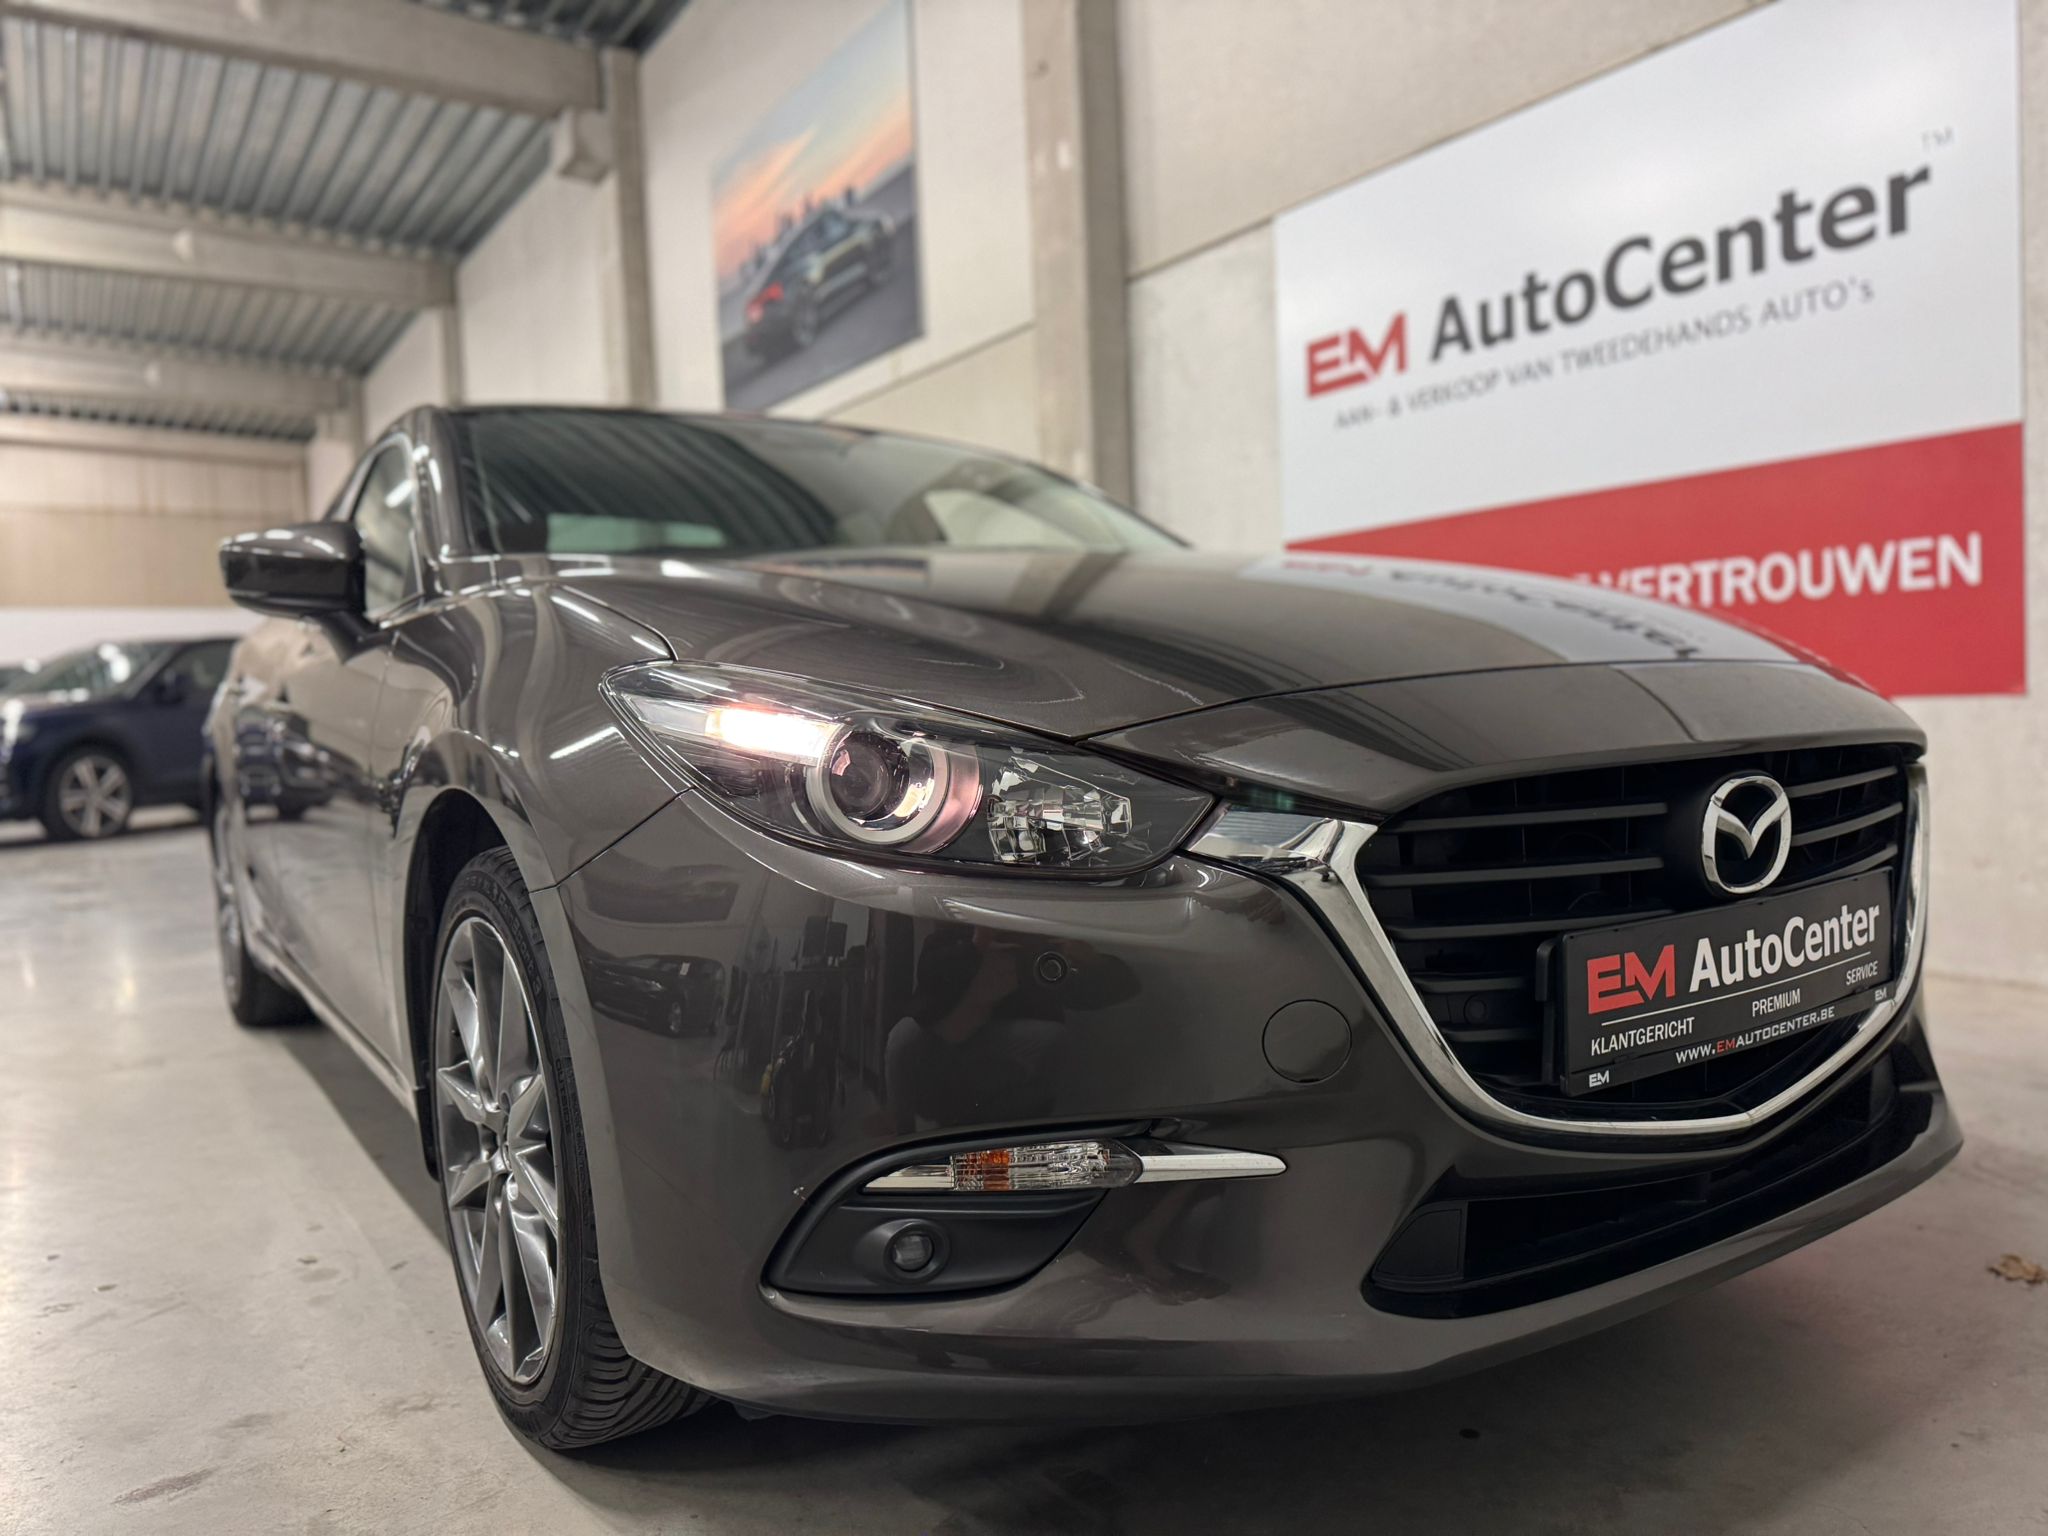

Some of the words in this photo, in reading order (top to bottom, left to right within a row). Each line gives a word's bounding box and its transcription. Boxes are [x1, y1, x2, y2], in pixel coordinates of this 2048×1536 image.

[1307, 312, 1407, 397] EM
[1430, 166, 1929, 362] AutoCenter
[1408, 371, 1499, 412] VERKOOP
[1506, 357, 1552, 386] VAN
[1561, 306, 1751, 374] TWEEDEHANDS
[1587, 944, 1675, 1014] EM
[1689, 905, 1879, 992] AutoCenter
[1591, 1016, 1695, 1056] KLANTGERICHT
[1752, 988, 1800, 1017] PREMIUM
[1846, 961, 1879, 986] SERVICE
[1589, 1070, 1610, 1088] EM
